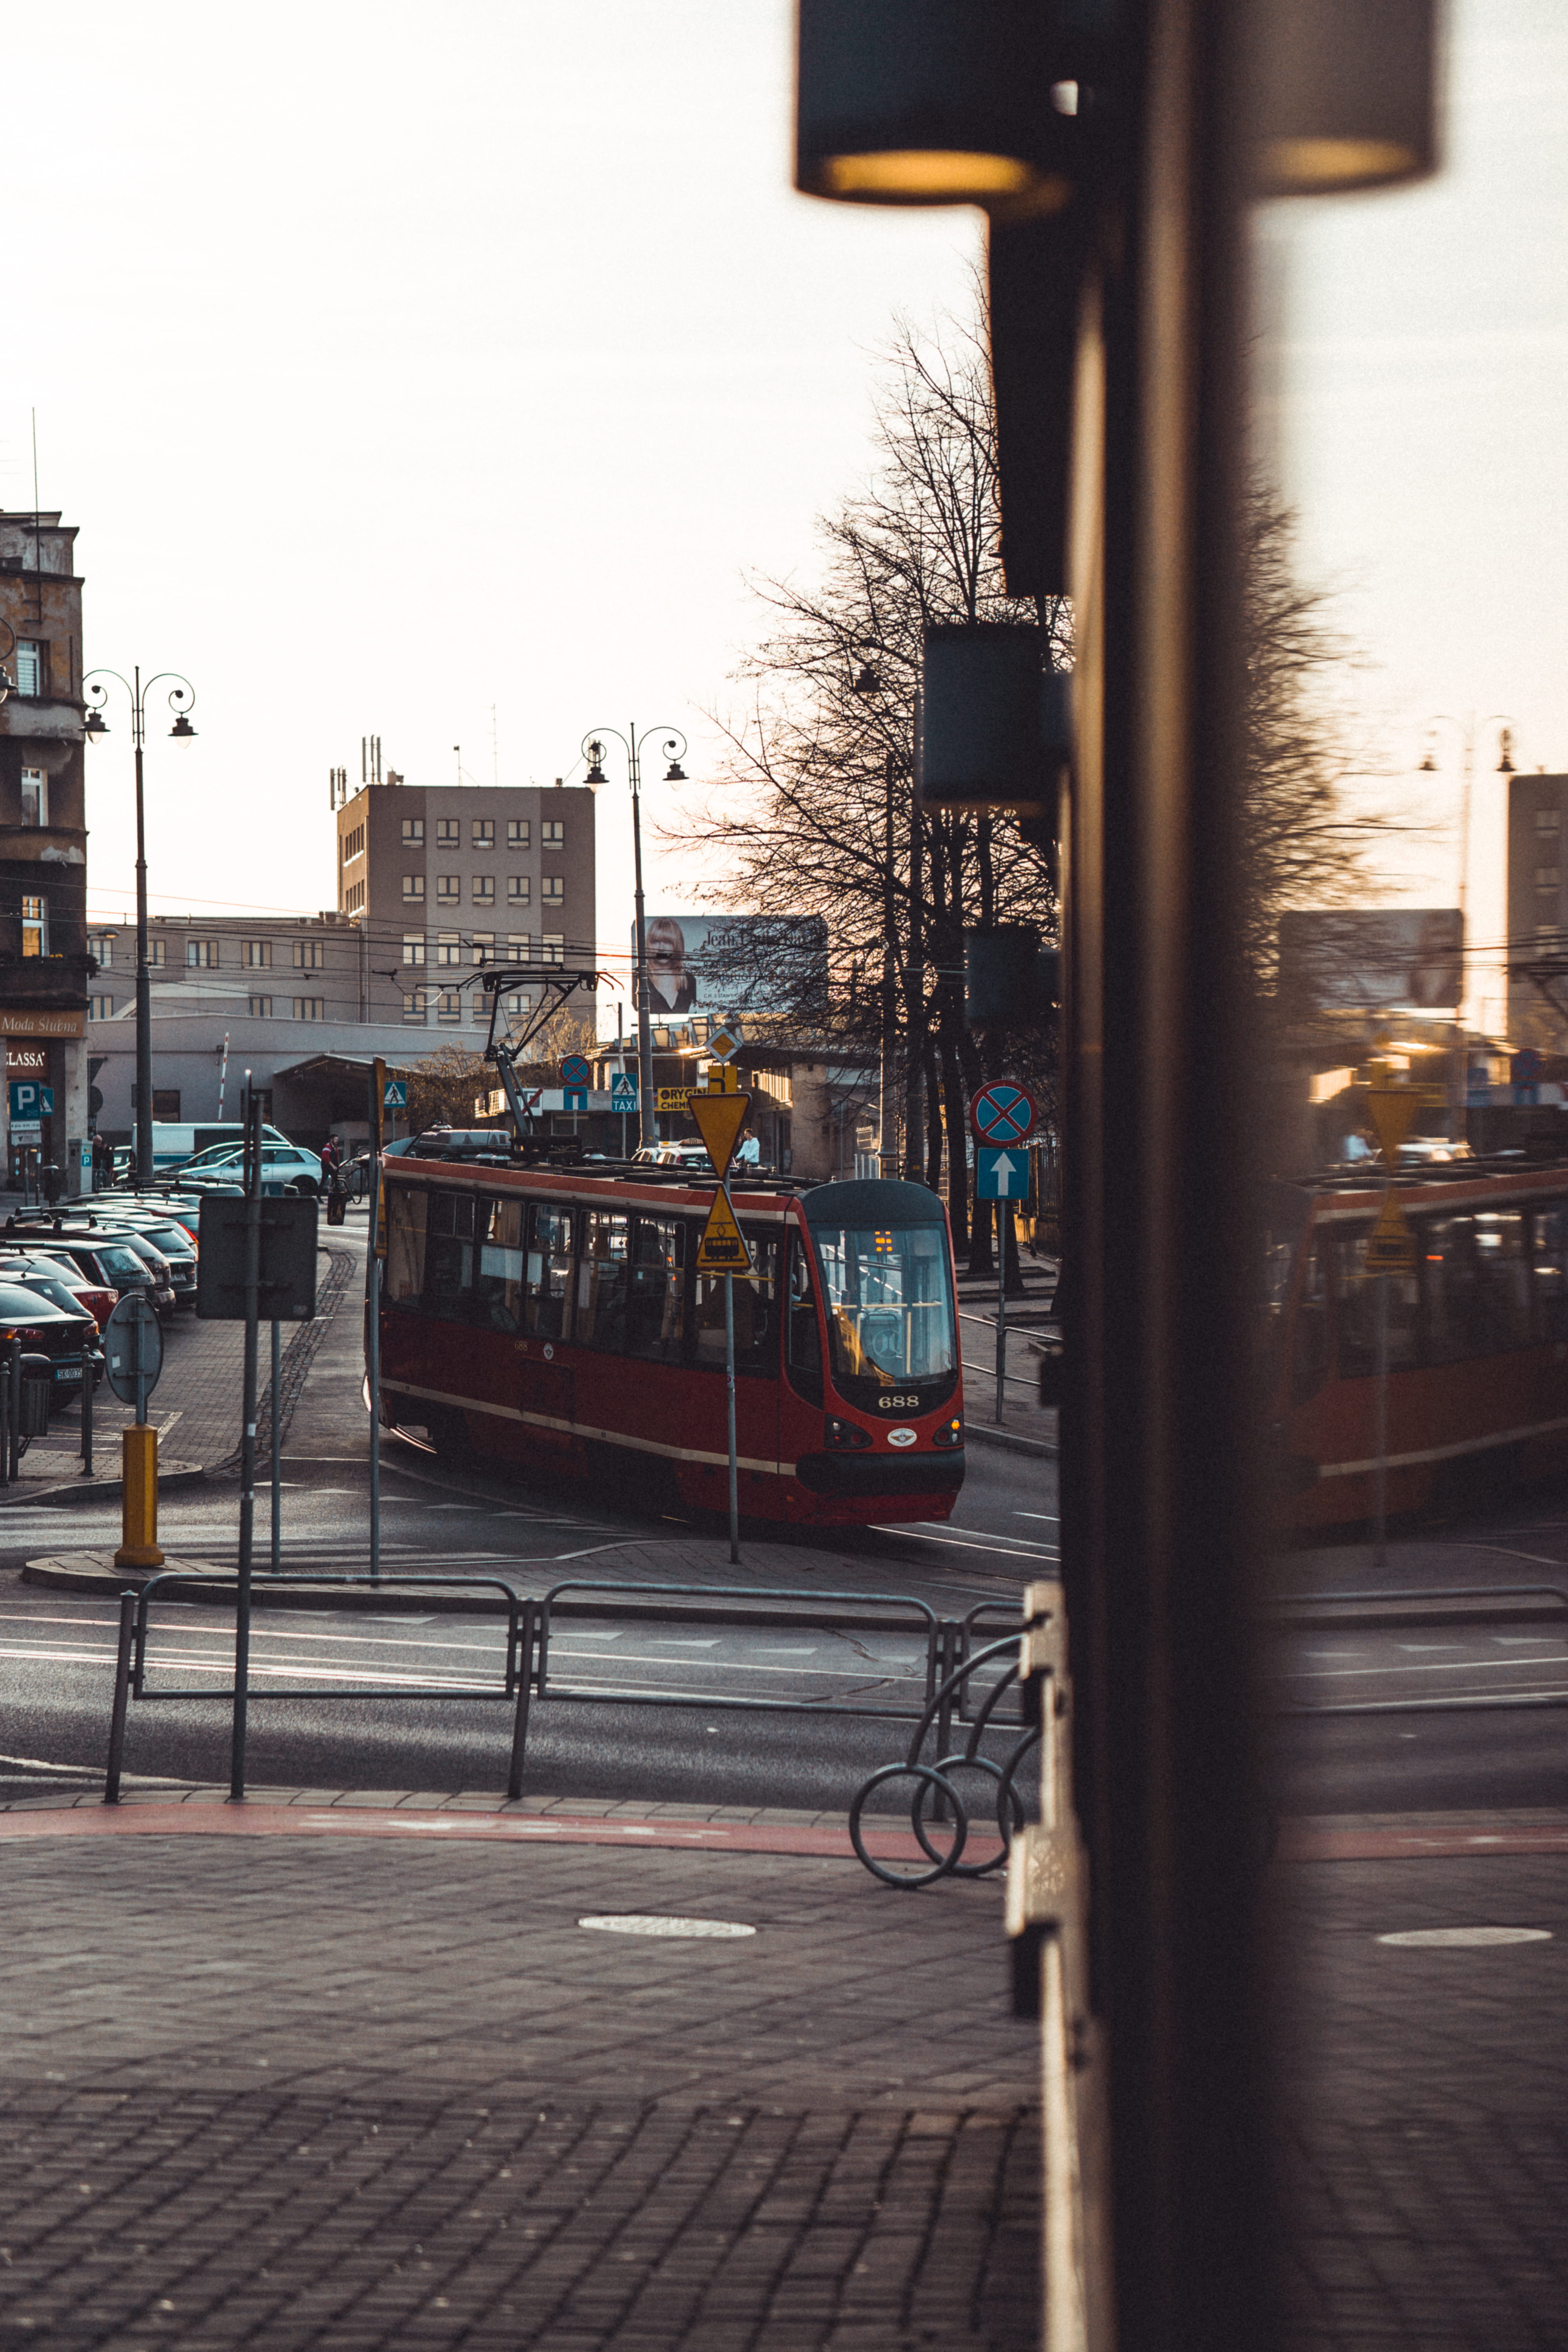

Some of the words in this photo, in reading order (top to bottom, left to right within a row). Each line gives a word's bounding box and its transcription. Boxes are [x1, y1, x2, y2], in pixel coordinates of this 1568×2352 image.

[2, 1017, 34, 1031] Moda
[38, 1014, 77, 1032] Ślubna
[18, 1086, 35, 1110] P
[661, 1088, 707, 1100] ORYGIN
[613, 1101, 636, 1111] TAXI
[661, 1102, 690, 1110] CHEMI
[84, 1156, 90, 1165] P
[58, 1370, 66, 1378] SK
[878, 1396, 919, 1408] 688
